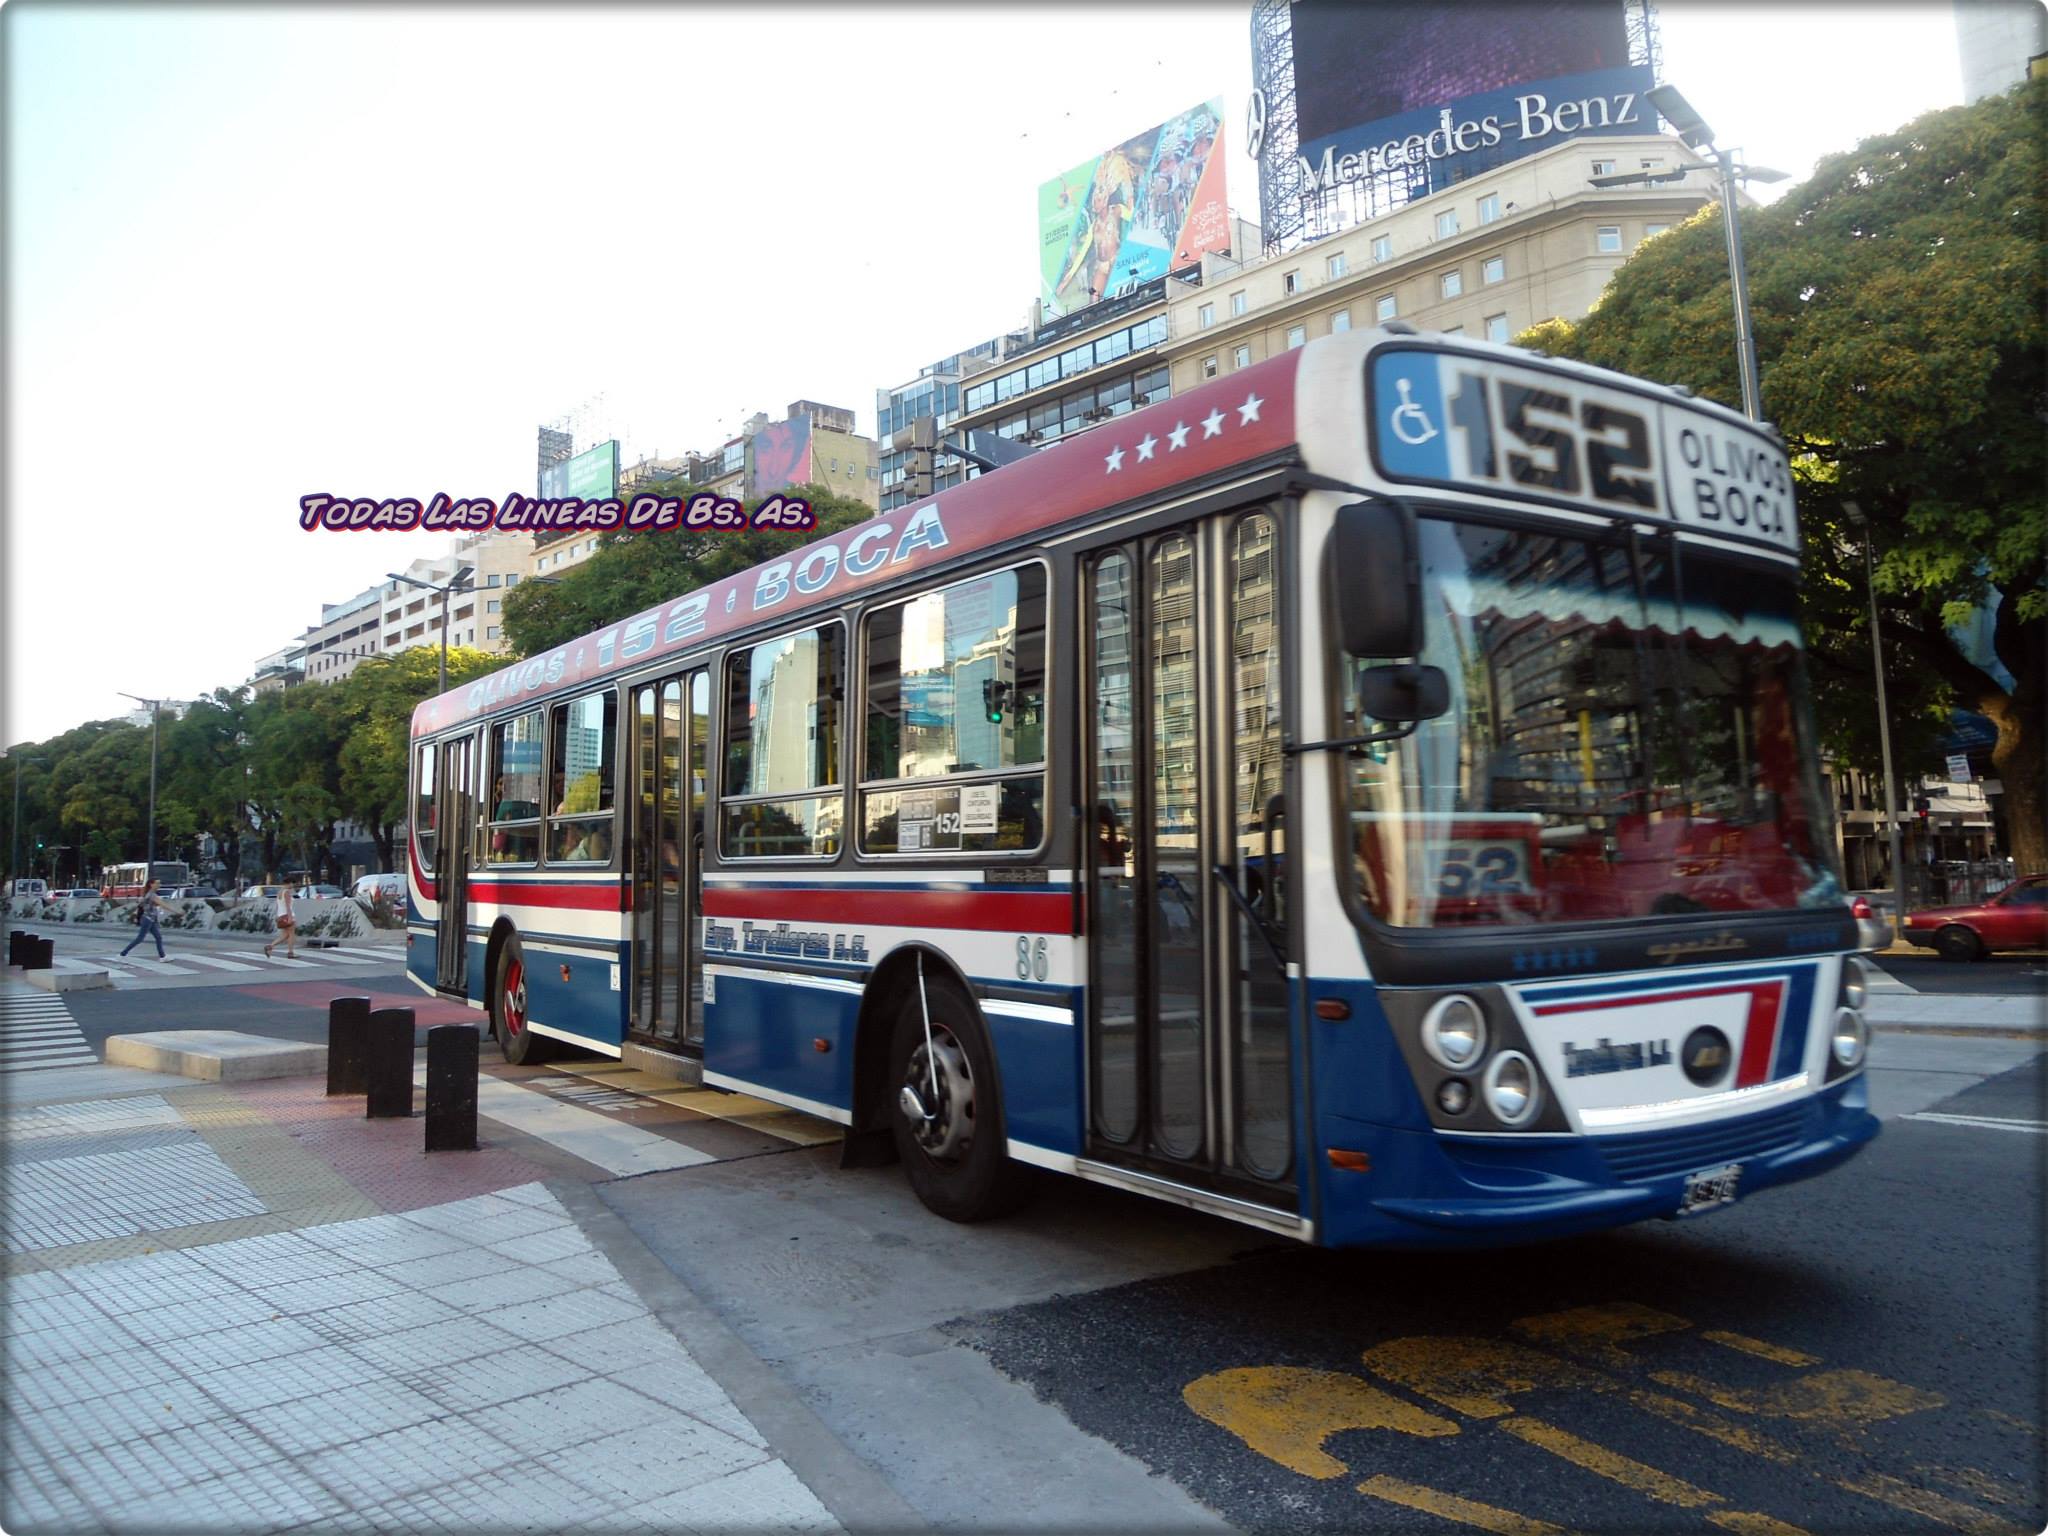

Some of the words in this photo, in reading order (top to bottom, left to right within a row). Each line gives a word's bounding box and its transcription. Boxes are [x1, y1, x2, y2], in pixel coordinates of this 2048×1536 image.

[1299, 91, 1639, 196] Mercedes-Benz
[1448, 371, 1659, 510] 152
[1694, 479, 1785, 535] BOCA
[466, 650, 565, 712] OLIVOS
[595, 593, 710, 670] 152
[753, 502, 950, 610] BOCA
[936, 812, 960, 834] 152
[1015, 935, 1048, 982] 86
